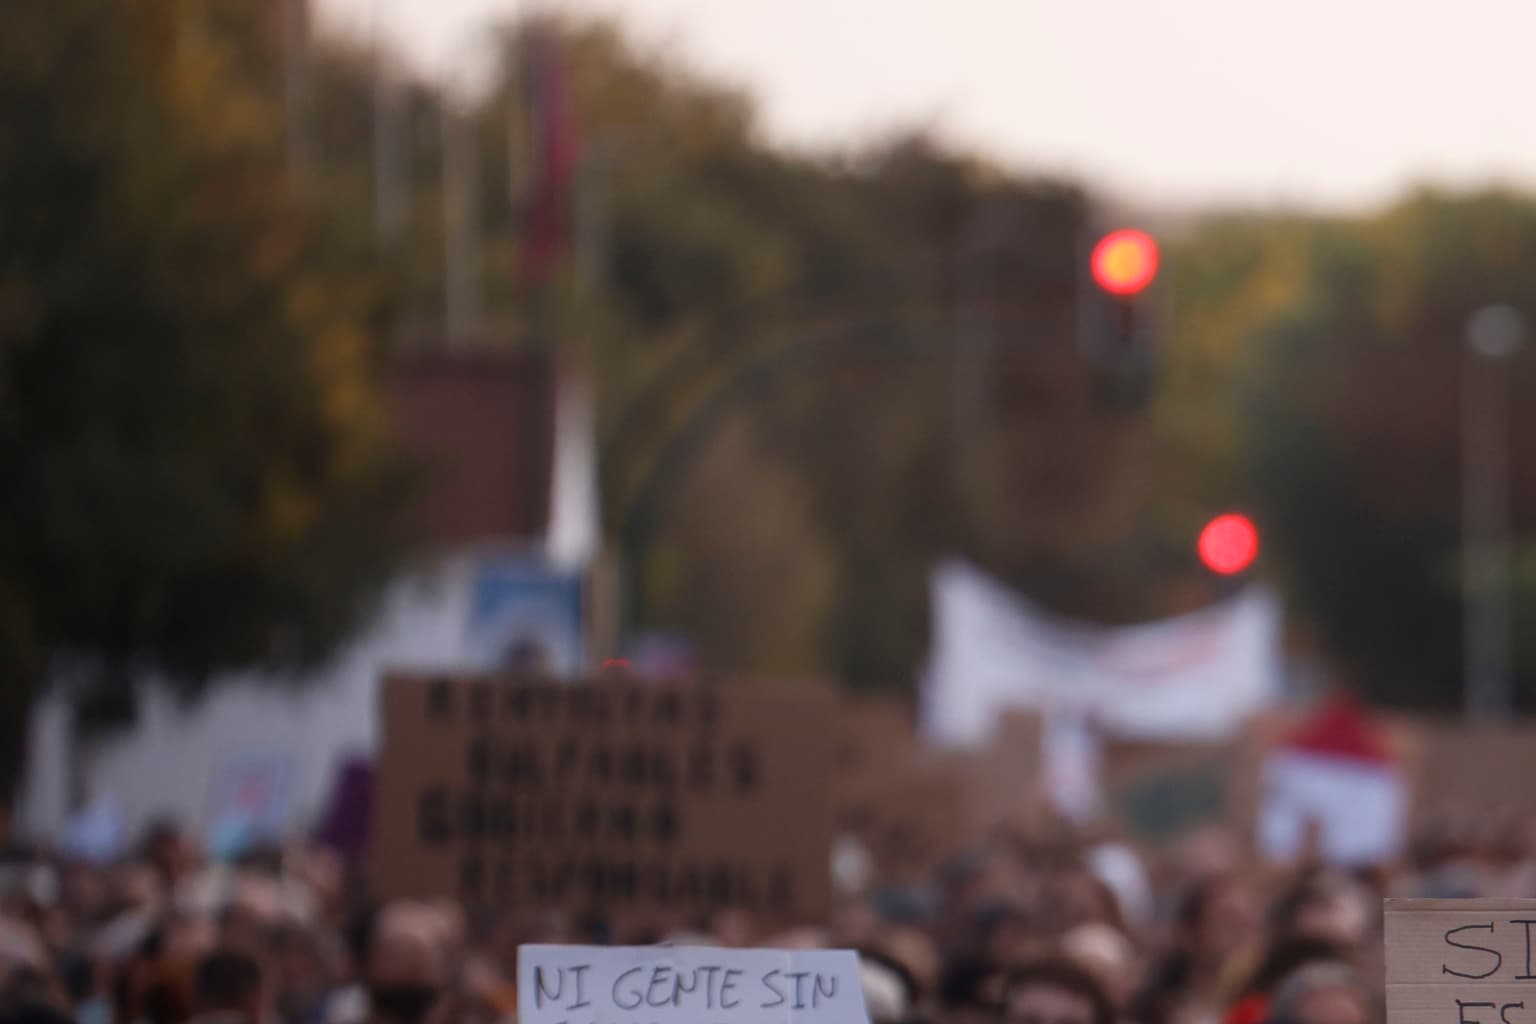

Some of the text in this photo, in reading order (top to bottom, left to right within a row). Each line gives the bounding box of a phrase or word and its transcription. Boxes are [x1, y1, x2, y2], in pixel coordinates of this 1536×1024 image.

[533, 964, 839, 1011] NI GENTE SIN
